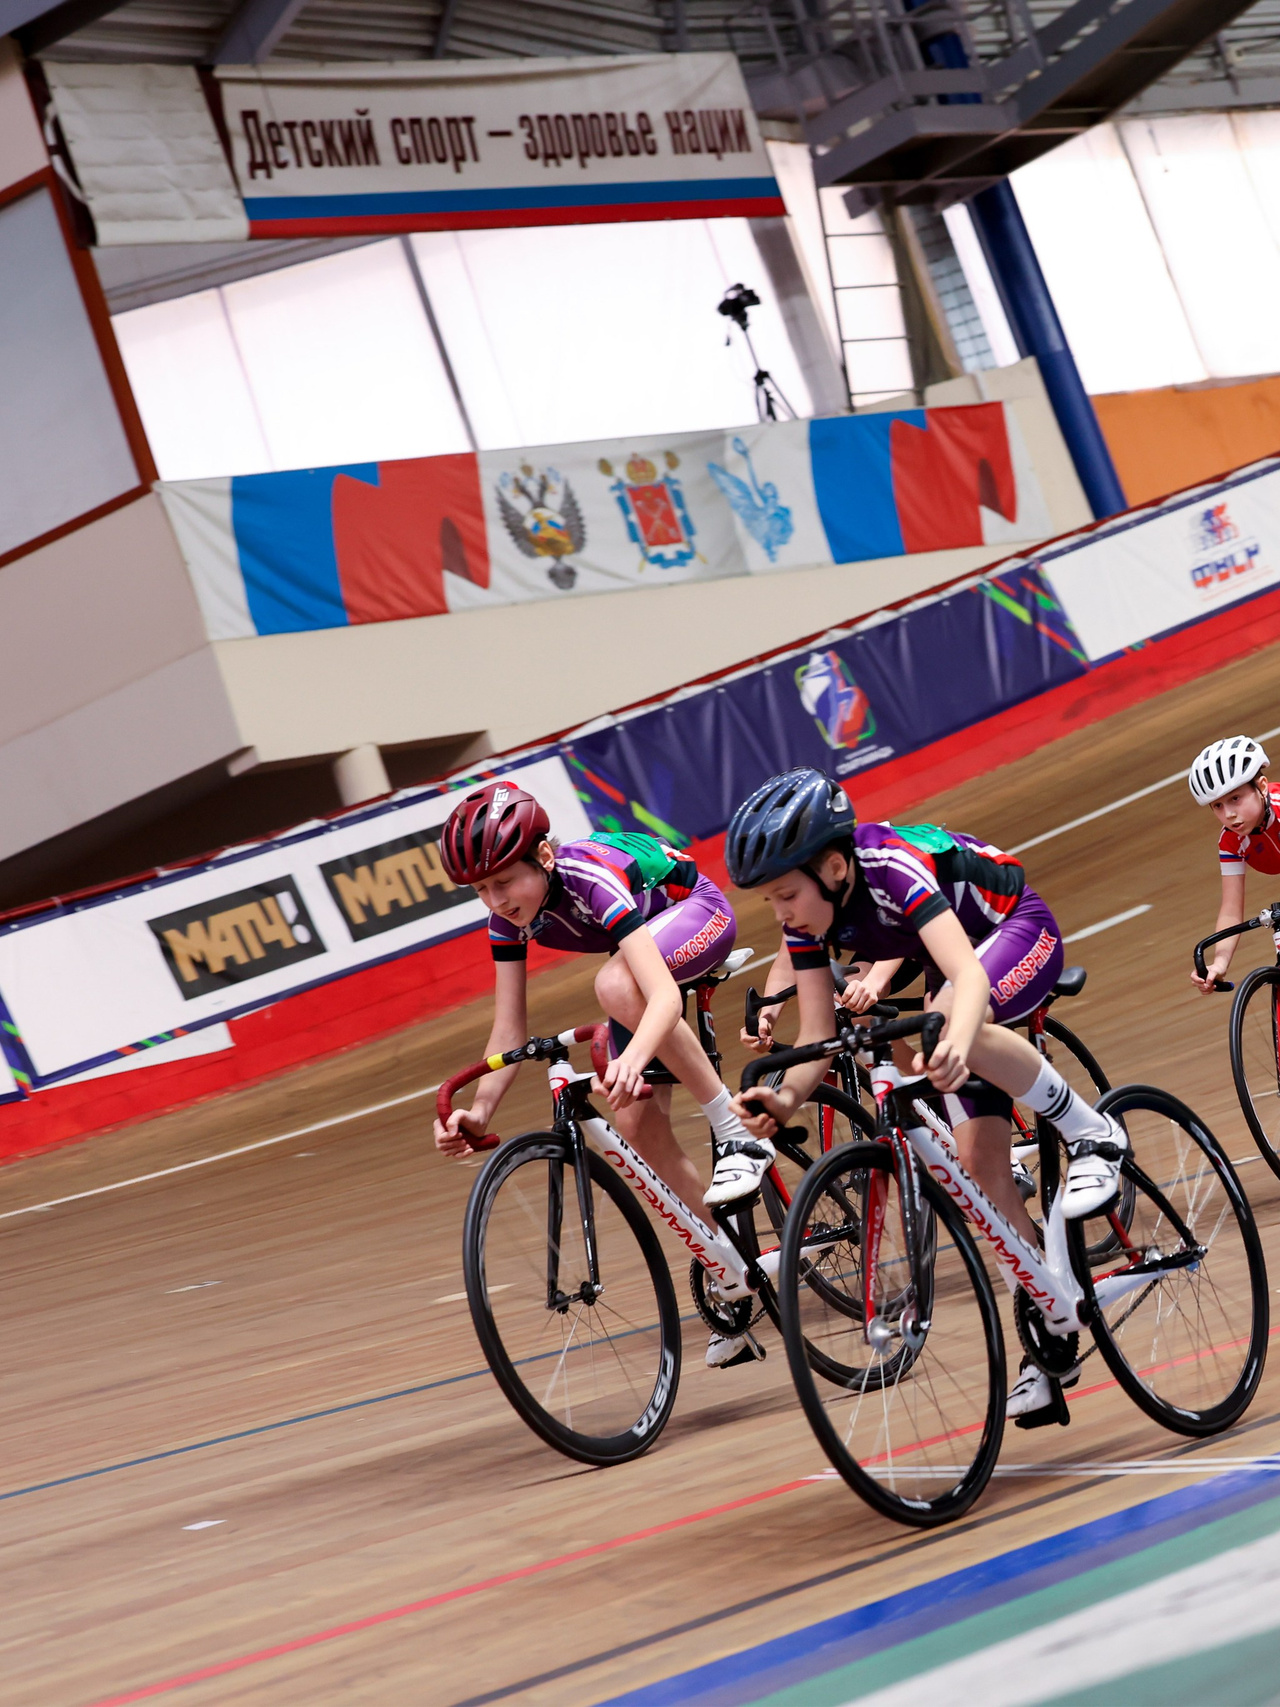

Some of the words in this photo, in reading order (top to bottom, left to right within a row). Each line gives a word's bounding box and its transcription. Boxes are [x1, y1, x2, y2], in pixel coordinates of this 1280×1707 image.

[241, 108, 381, 180] Детский
[390, 116, 480, 174] спорт
[518, 112, 659, 169] здоровье
[664, 109, 752, 161] нации
[489, 788, 510, 820] MET
[162, 890, 313, 983] МАТЧ!
[665, 907, 732, 971] LOKOSPHINX
[990, 926, 1058, 1006] LOKOSPHINX
[929, 1164, 1056, 1312] PINARELLO
